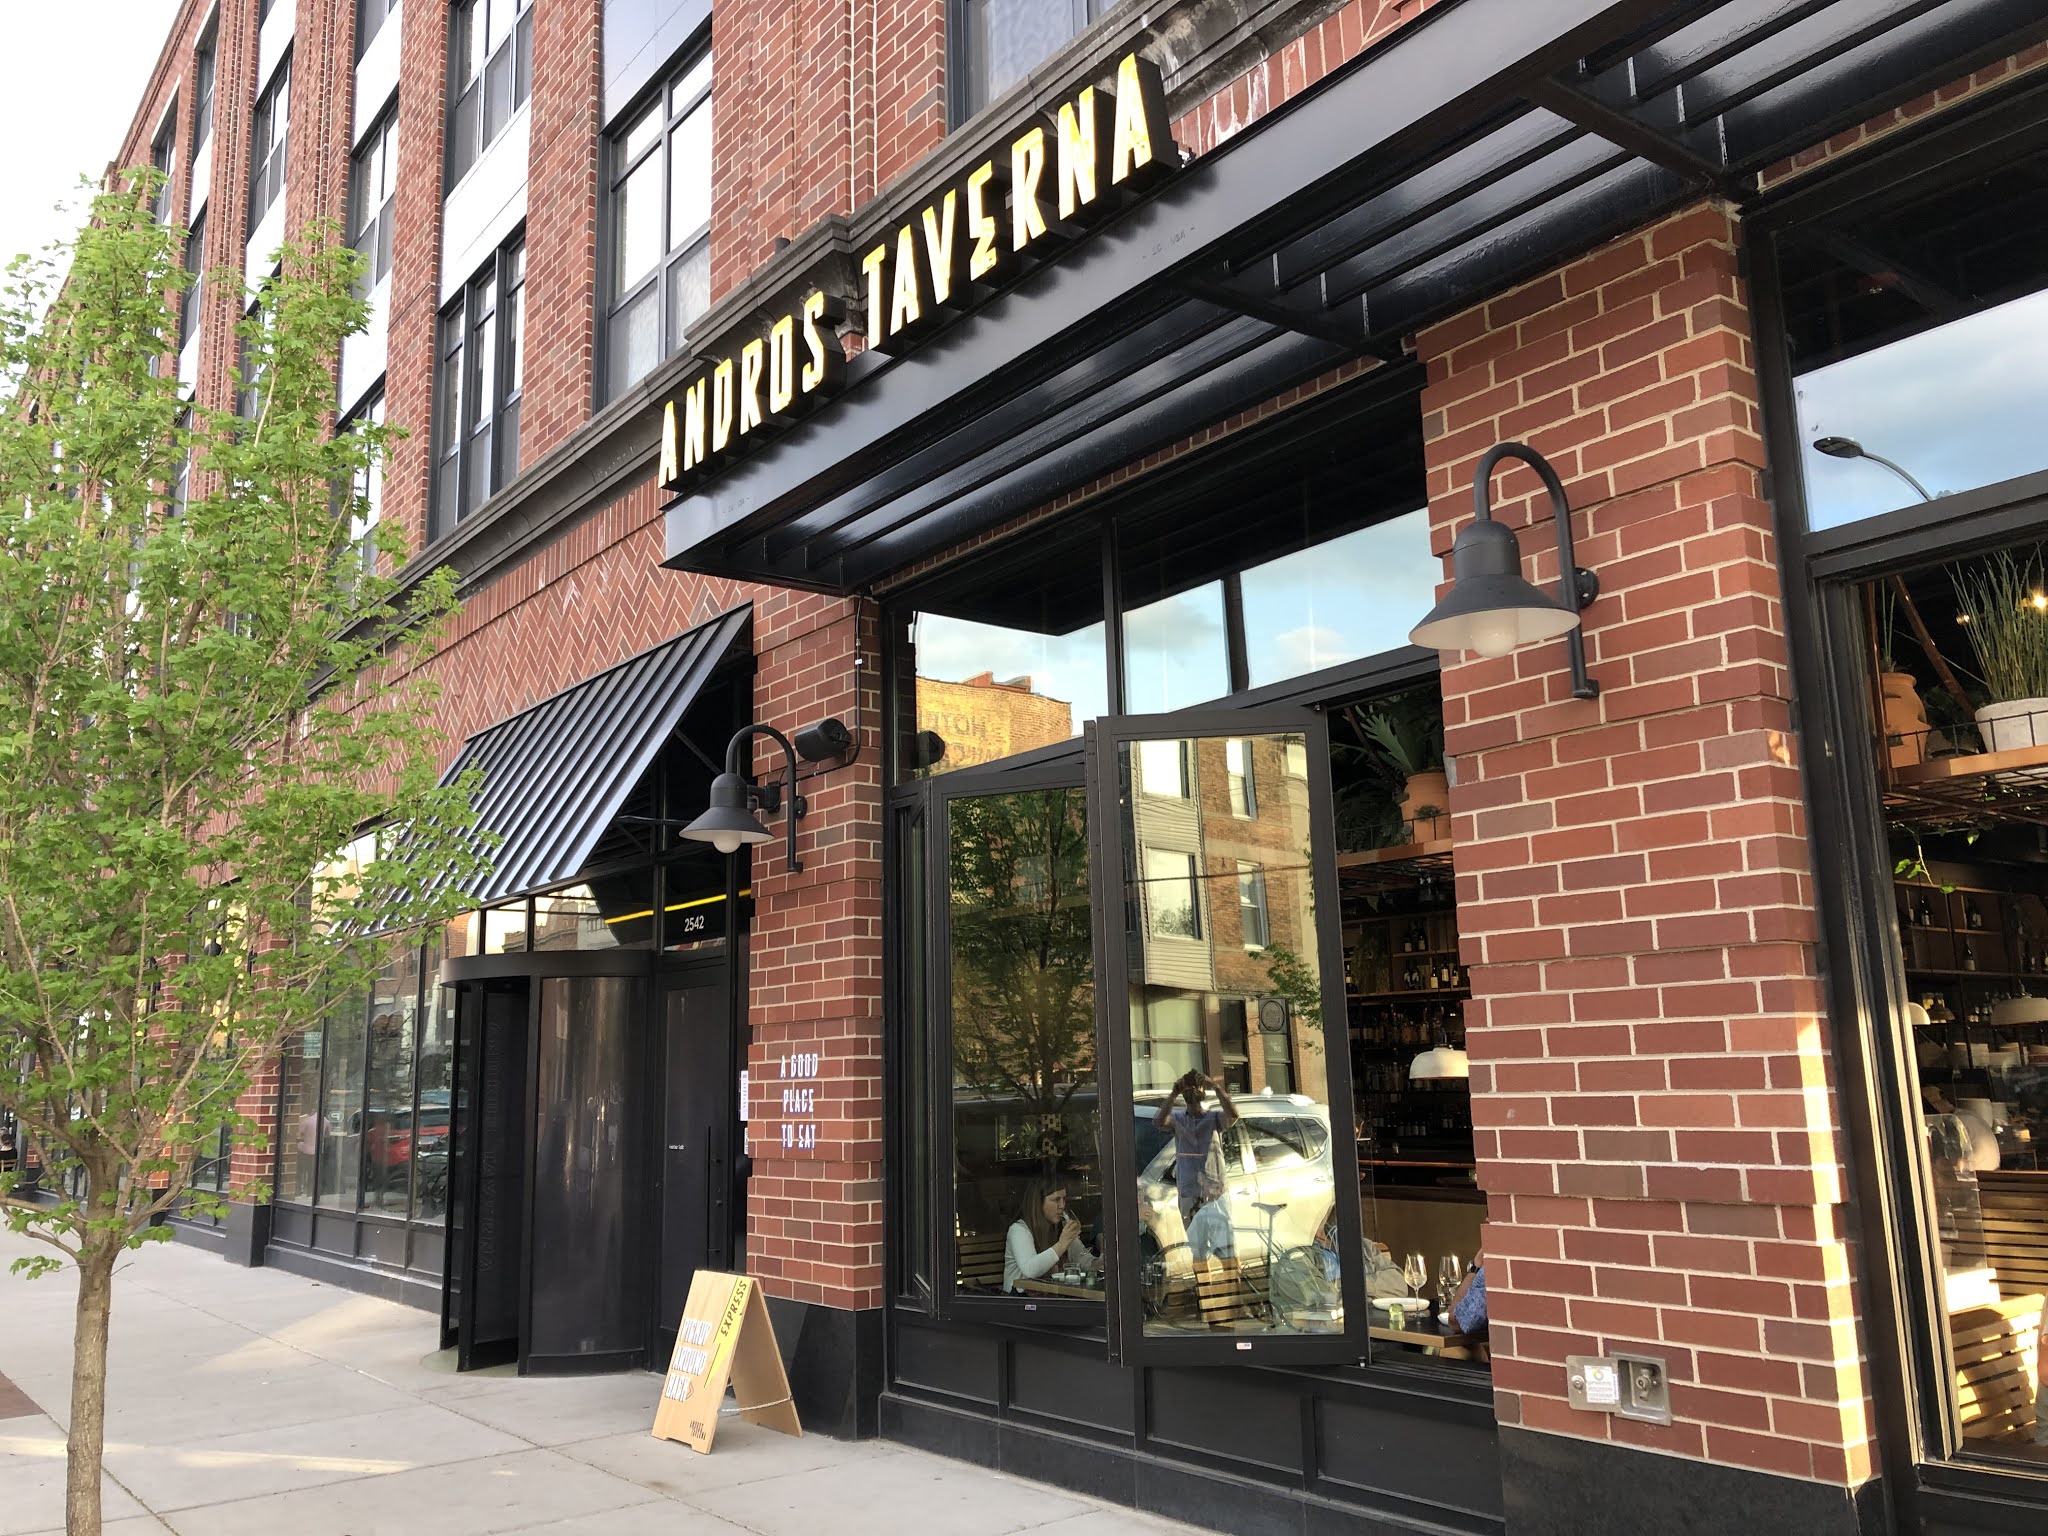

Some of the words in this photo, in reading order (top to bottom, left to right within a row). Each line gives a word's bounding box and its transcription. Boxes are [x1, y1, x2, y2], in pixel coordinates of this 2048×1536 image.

[657, 291, 827, 488] ANDROS
[862, 52, 1153, 352] TAVERNA
[684, 915, 705, 932] 2542
[780, 1055, 786, 1078] A
[790, 1053, 818, 1077] GOOD
[783, 1089, 814, 1113] PLACE
[781, 1124, 793, 1148] TO
[798, 1124, 815, 1149] EAT
[720, 1281, 747, 1337] EXPRESS
